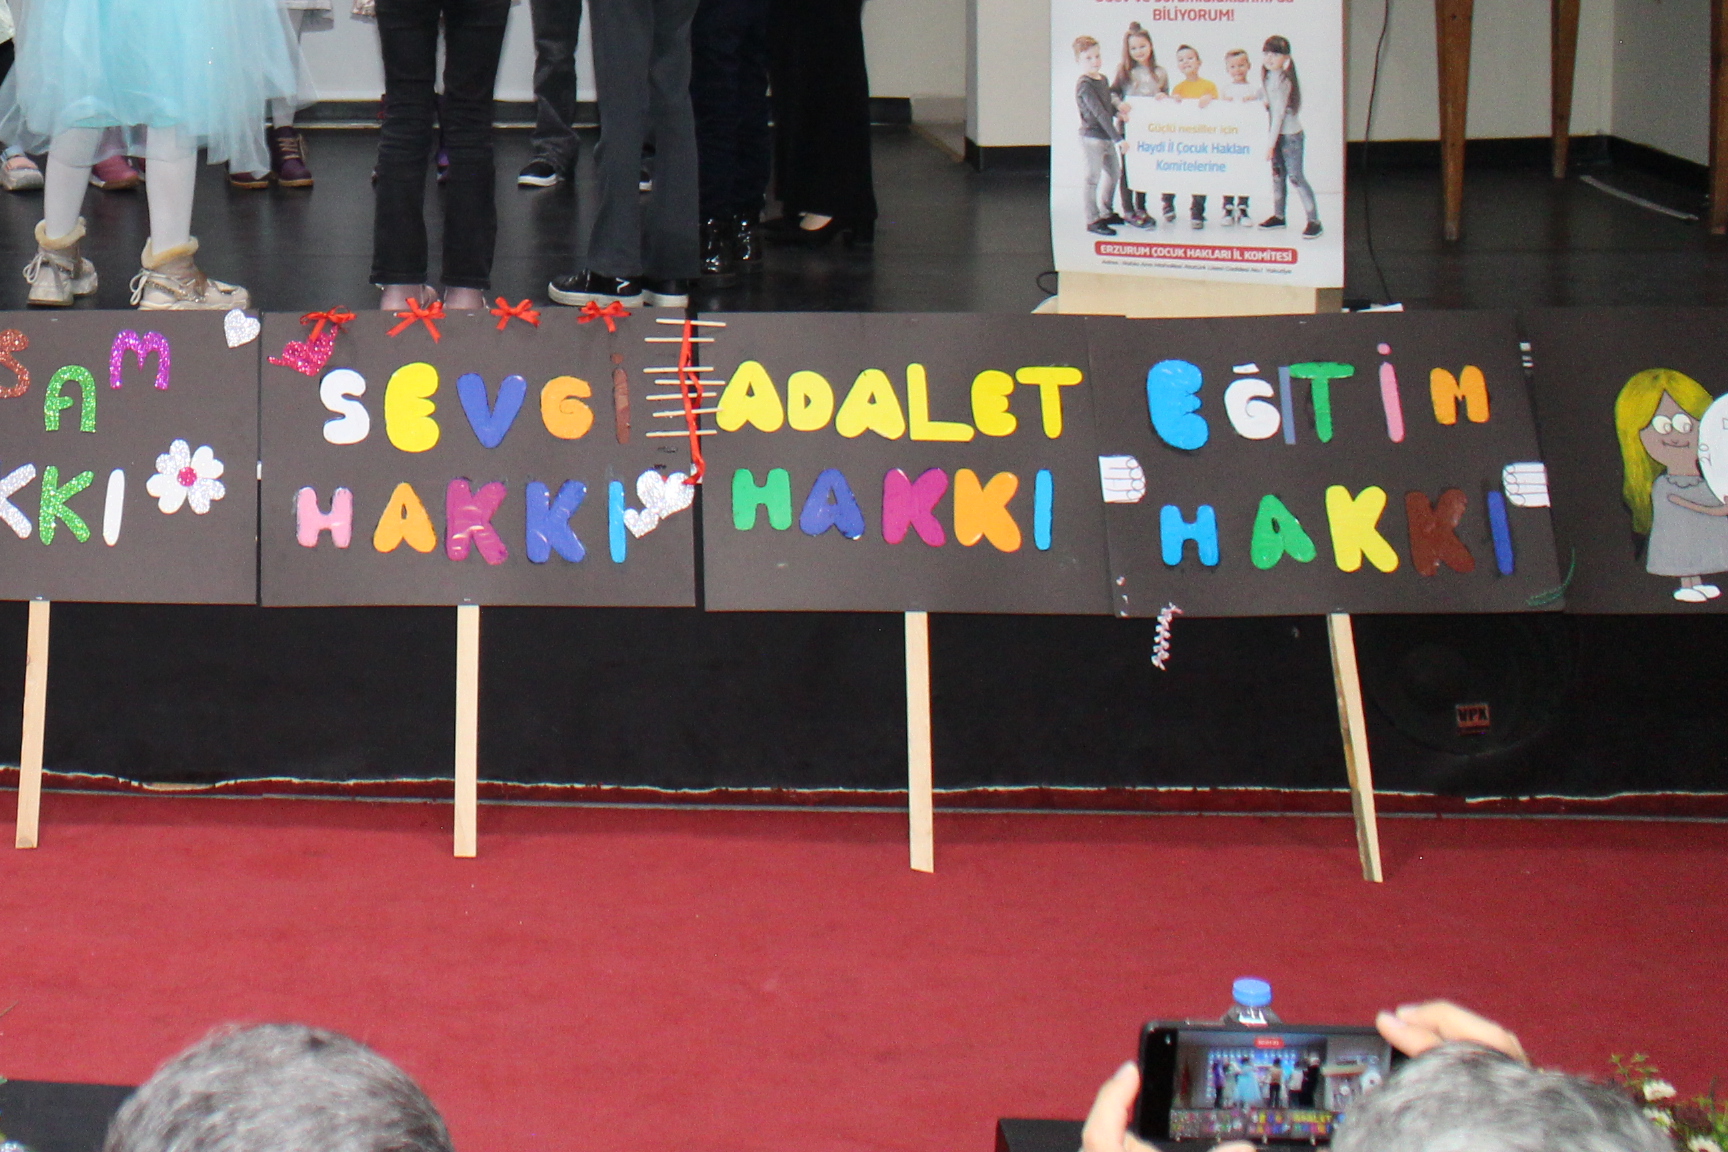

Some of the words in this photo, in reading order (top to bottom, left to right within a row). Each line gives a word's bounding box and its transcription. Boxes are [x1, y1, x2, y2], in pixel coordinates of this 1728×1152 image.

[1153, 6, 1235, 22] BİLİYORUM!
[1137, 140, 1165, 155] Haydi
[1176, 141, 1208, 155] Çocuk
[1156, 159, 1227, 173] Komitelerine
[1100, 244, 1150, 256] ERZURUM
[1152, 246, 1185, 258] ÇOCUK
[1186, 248, 1232, 259] HAKLARI
[1233, 248, 1242, 260] İL
[1244, 249, 1293, 262] KOMİTESİ
[319, 352, 631, 453] SEVGİ
[716, 360, 1083, 442] ADALET
[295, 477, 627, 566] HAKKI
[731, 467, 1054, 553] HAKKI
[1160, 484, 1516, 577] HAKKI
